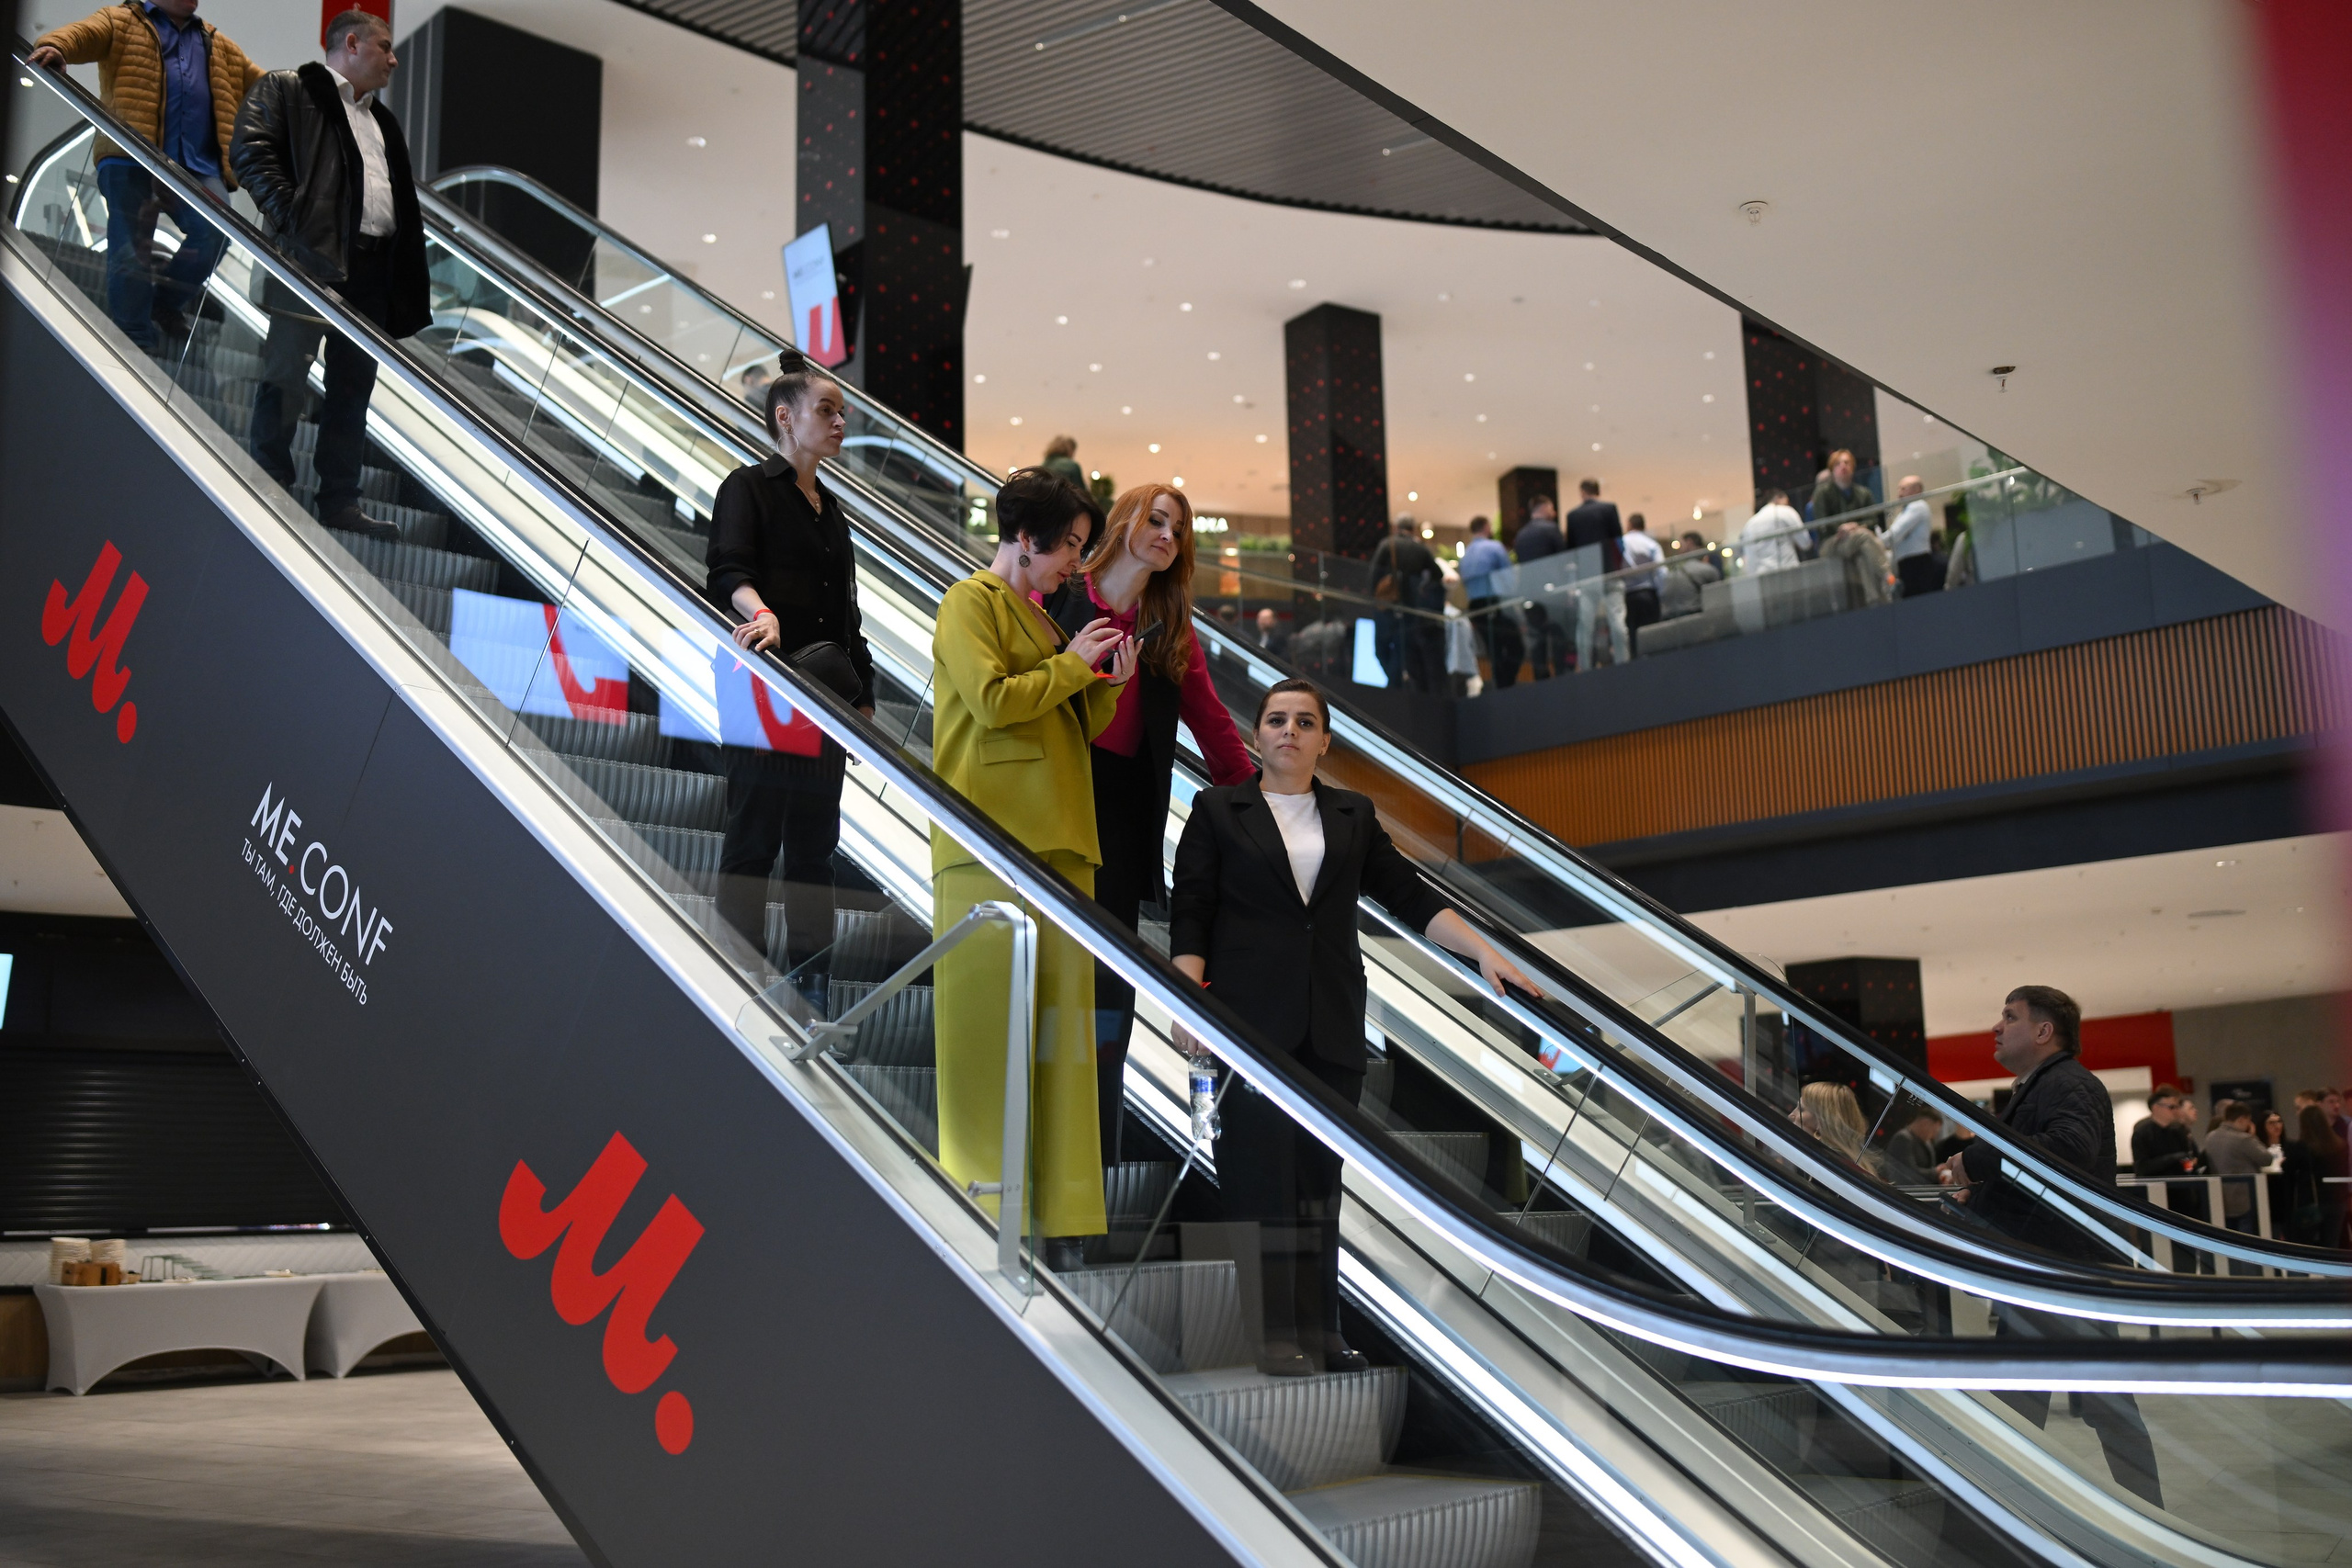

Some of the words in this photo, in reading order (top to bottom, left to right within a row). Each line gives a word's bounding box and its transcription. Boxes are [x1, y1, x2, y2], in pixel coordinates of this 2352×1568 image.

[242, 838, 256, 865] ТЫ
[254, 854, 277, 897] ТАМ,
[277, 885, 298, 917] ГДЕ
[293, 907, 343, 973] ДОЛЖЕН
[341, 962, 368, 1006] БЫТЬ
[251, 782, 393, 965] ME.CONF
